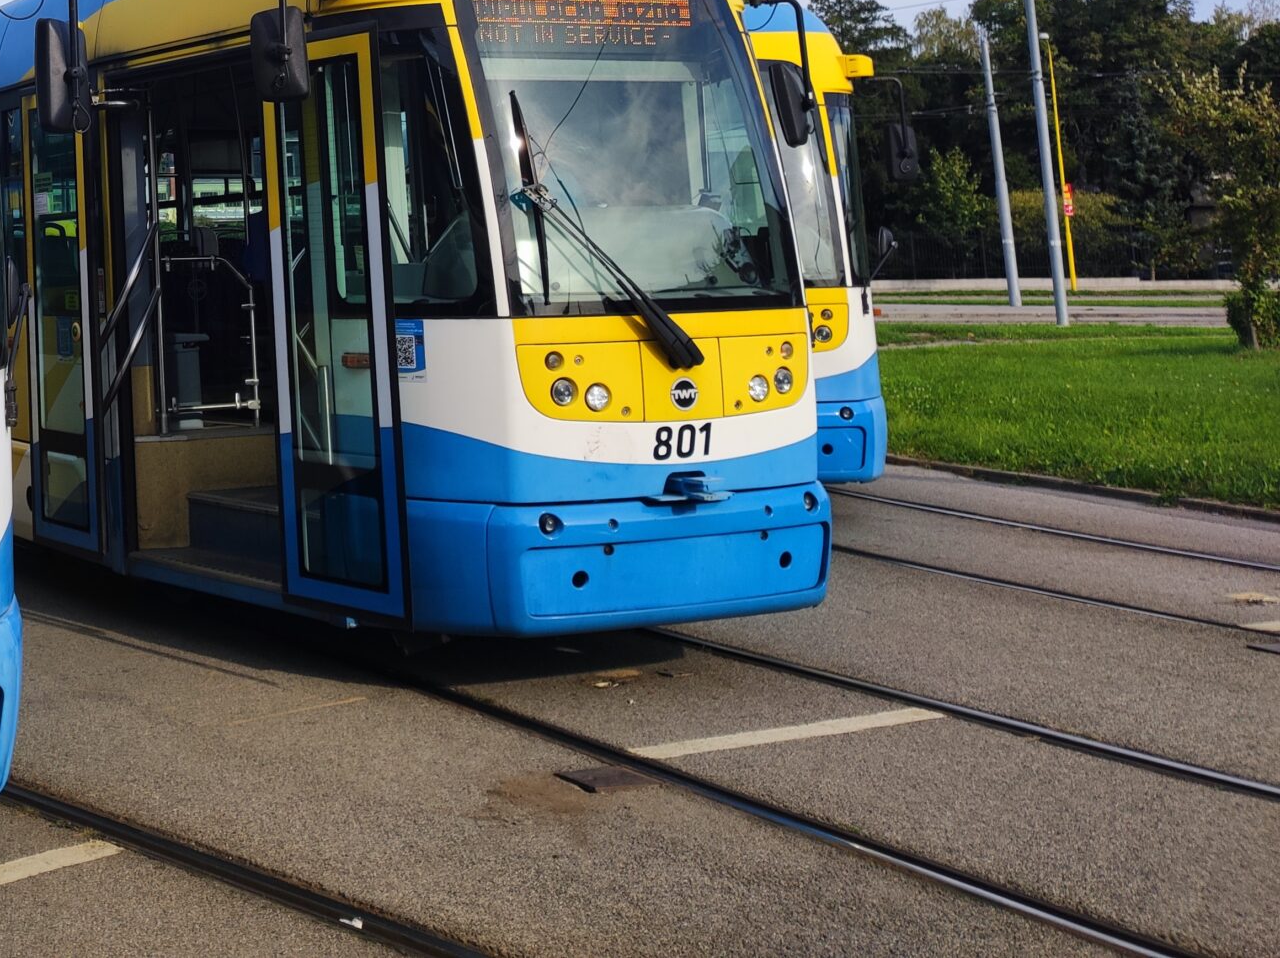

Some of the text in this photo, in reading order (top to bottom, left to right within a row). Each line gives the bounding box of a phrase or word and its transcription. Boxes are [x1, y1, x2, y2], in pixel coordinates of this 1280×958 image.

[480, 24, 522, 43] NOT
[534, 25, 554, 43] IN
[565, 25, 657, 46] SERVICE
[653, 422, 712, 461] 801
